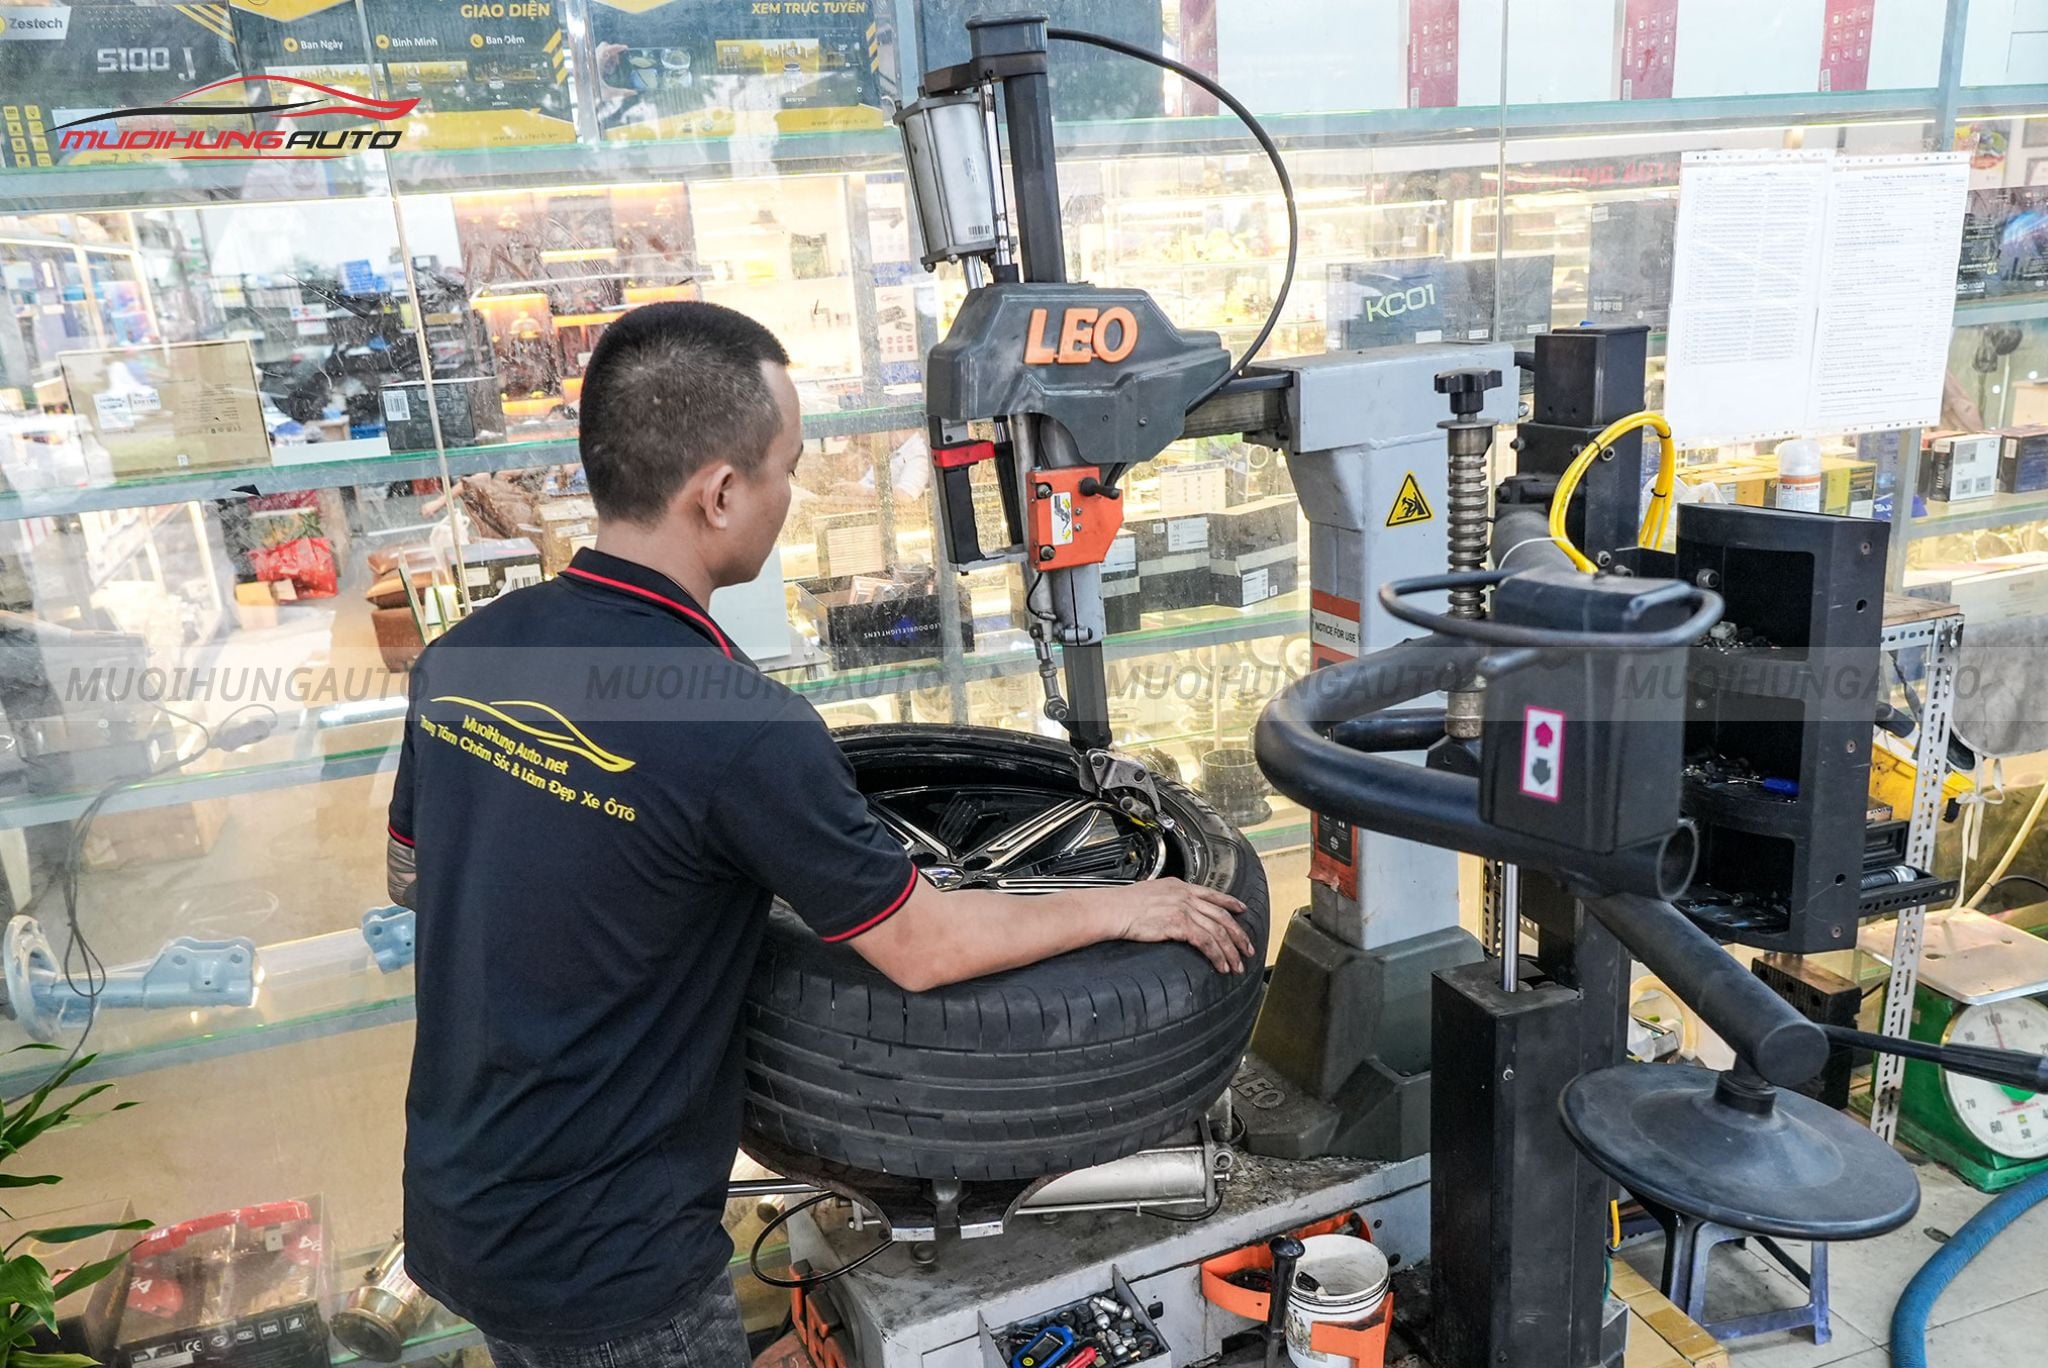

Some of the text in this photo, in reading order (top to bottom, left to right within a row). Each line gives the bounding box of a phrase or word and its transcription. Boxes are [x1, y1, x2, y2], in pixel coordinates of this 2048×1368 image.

[460, 0, 550, 20] GIAO DIỆN
[752, 3, 781, 14] XEM
[9, 17, 63, 29] Zestech
[301, 40, 318, 49] Ban
[414, 37, 437, 46] Minh
[486, 36, 503, 45] Ban
[97, 47, 170, 73] S100
[1023, 306, 1138, 364] LEO
[863, 630, 881, 639] LENS
[882, 627, 902, 637] LIGHT
[1315, 621, 1356, 643] NOTICE FOR USE
[510, 763, 520, 777] &
[548, 780, 577, 803] Đẹp
[580, 791, 601, 809] Xe
[1230, 1068, 1286, 1110] LEO
[1990, 1120, 2002, 1134] 60
